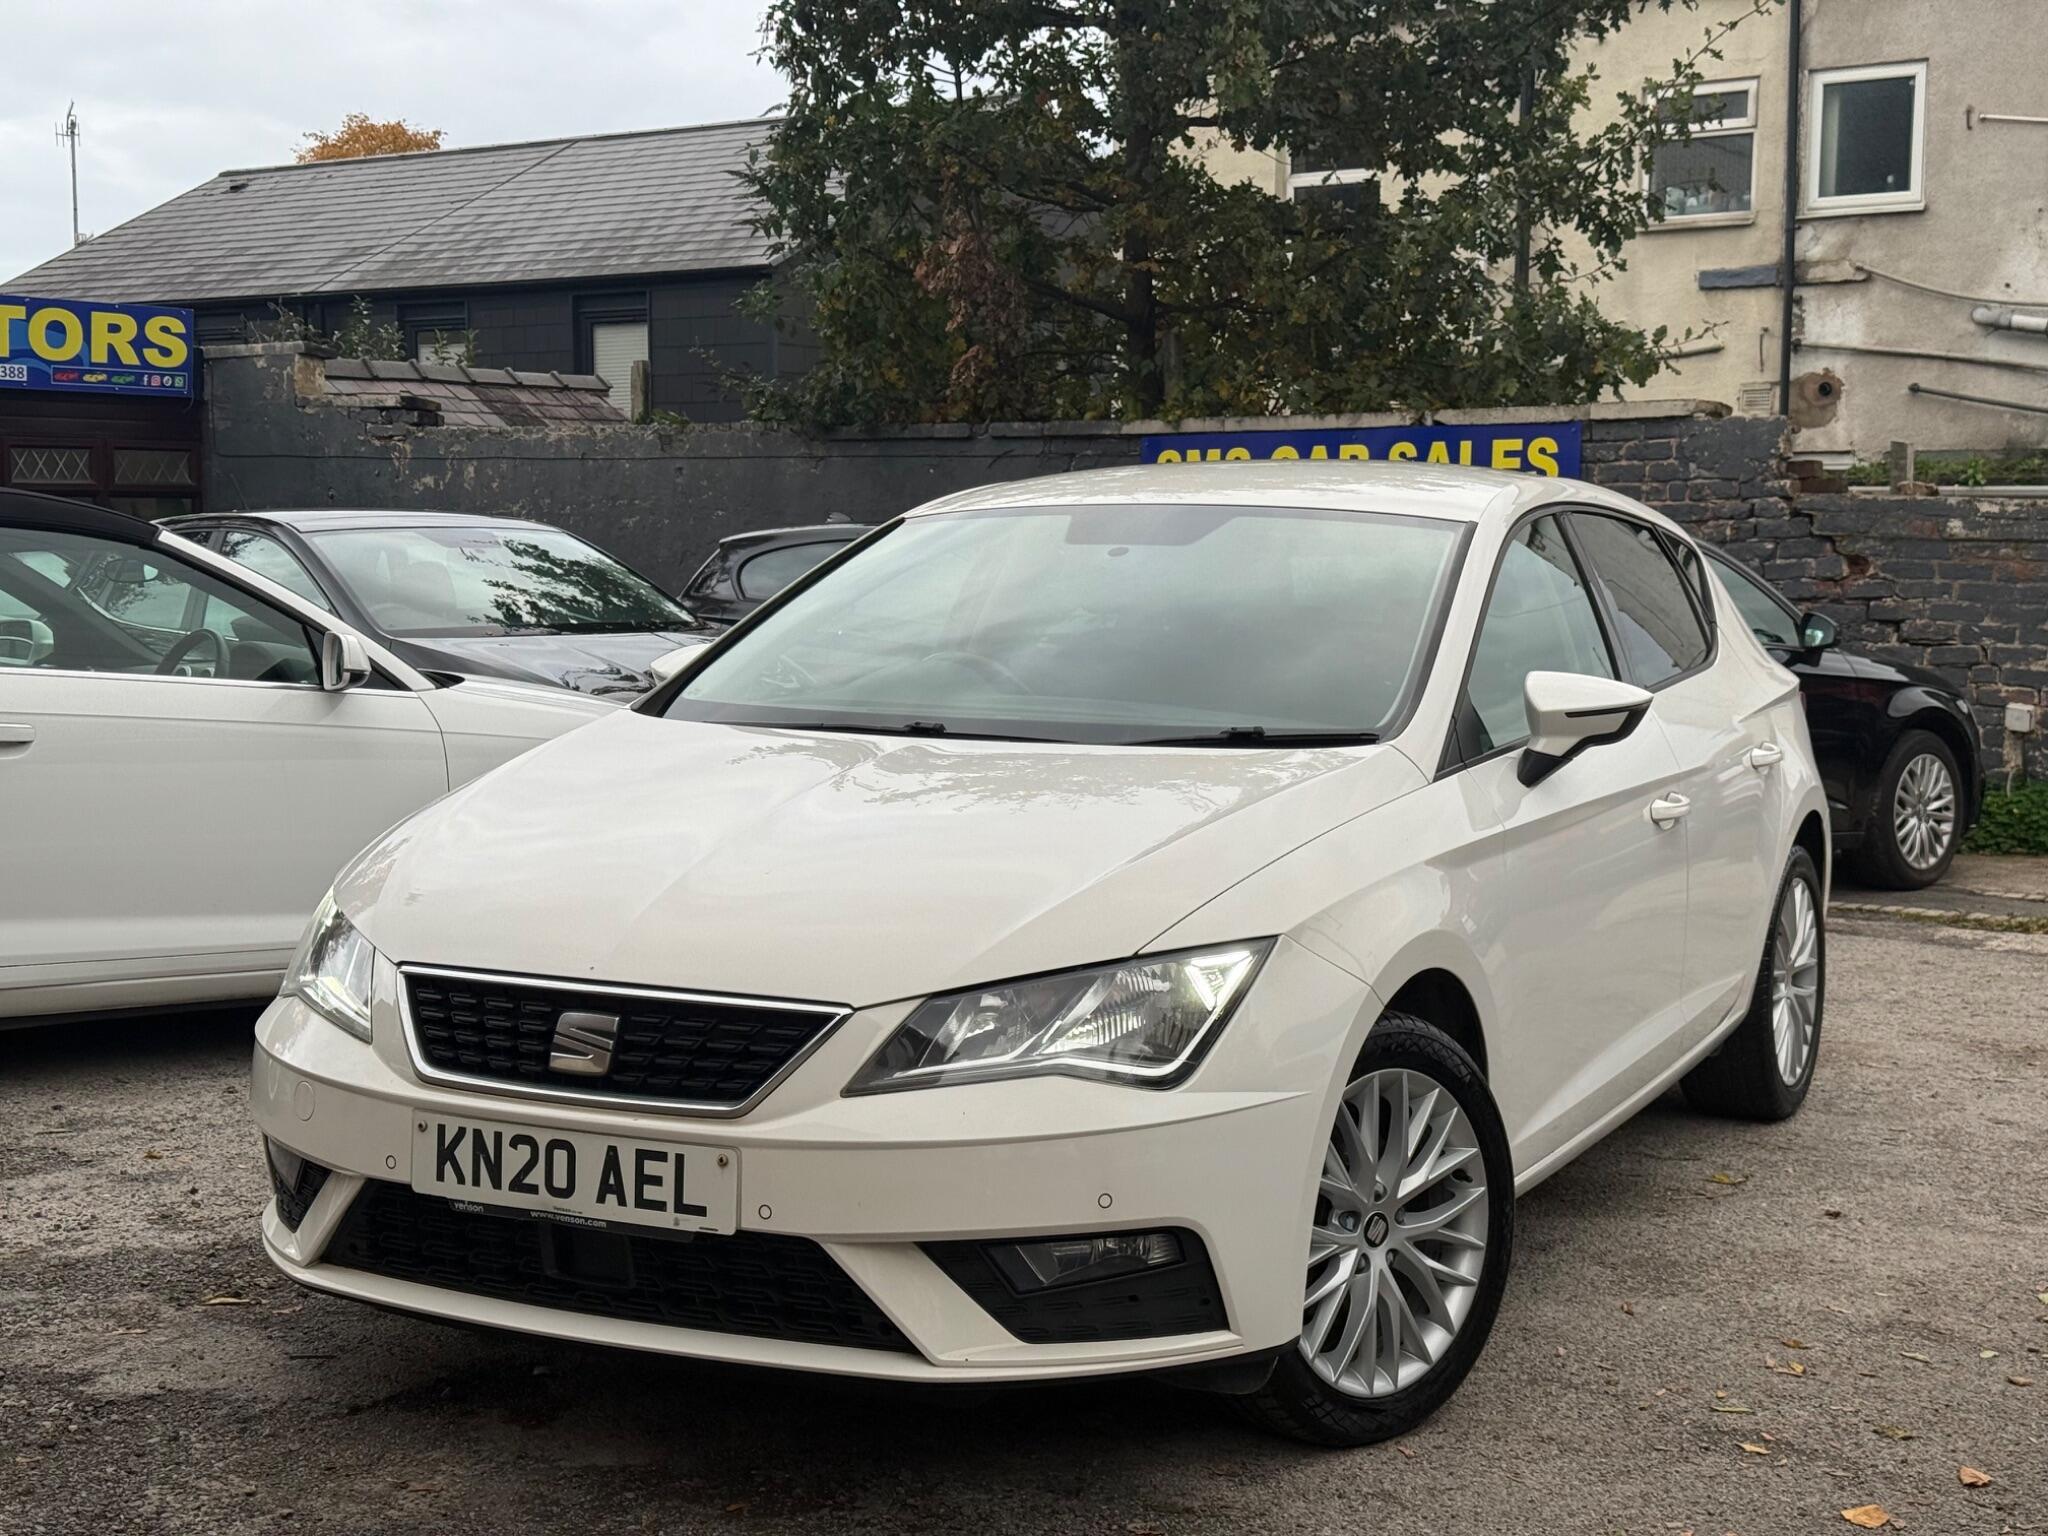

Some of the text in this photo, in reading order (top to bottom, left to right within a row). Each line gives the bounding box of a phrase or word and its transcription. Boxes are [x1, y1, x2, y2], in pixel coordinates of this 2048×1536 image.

[0, 305, 188, 368] TORS
[0, 366, 25, 379] 388
[436, 1123, 708, 1218] KN20 AEL
[530, 1210, 608, 1229] www.venson.com
